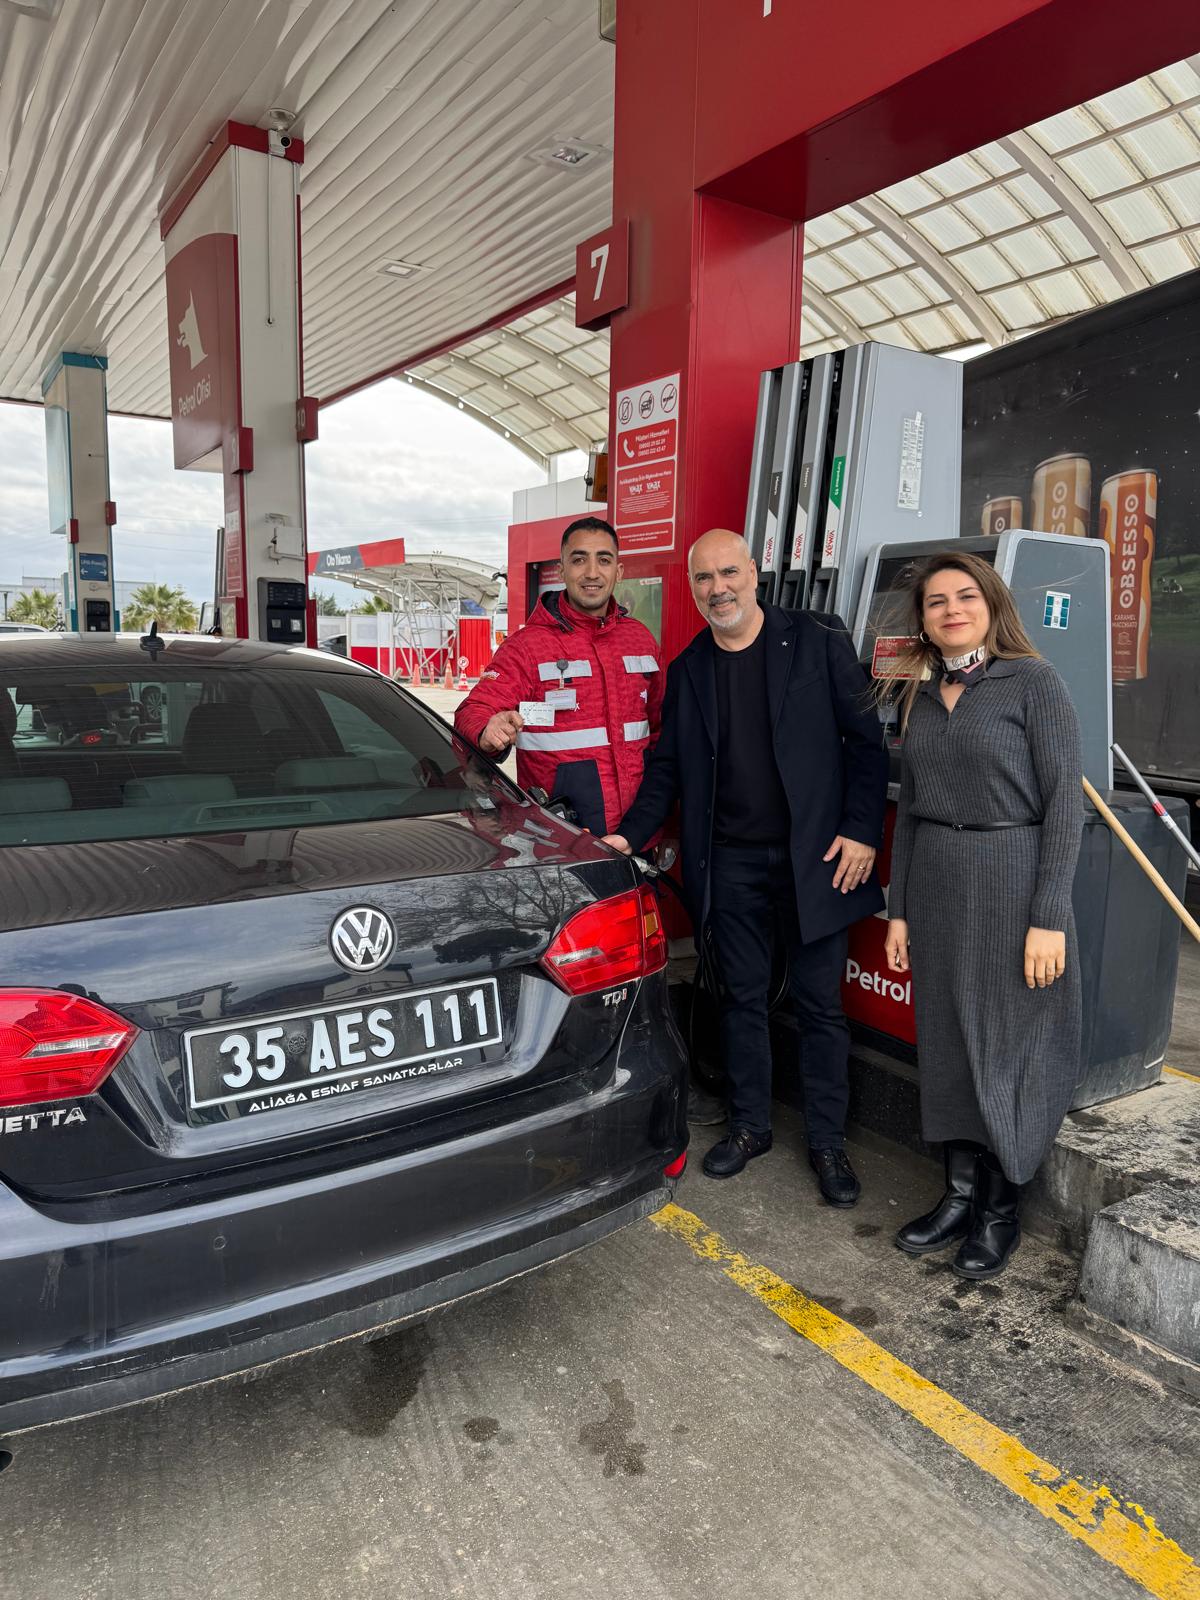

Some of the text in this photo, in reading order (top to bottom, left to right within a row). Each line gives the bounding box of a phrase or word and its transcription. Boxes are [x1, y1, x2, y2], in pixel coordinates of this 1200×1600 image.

[591, 243, 610, 301] 7
[178, 375, 211, 416] Petrol Ofisi
[326, 554, 335, 567] Oto
[1119, 494, 1139, 609] OBSESSO
[845, 958, 911, 1006] Petrol
[219, 988, 488, 1089] 35 AES 111
[248, 1057, 464, 1113] ALİAĞA ESNAF SANATKARLAR
